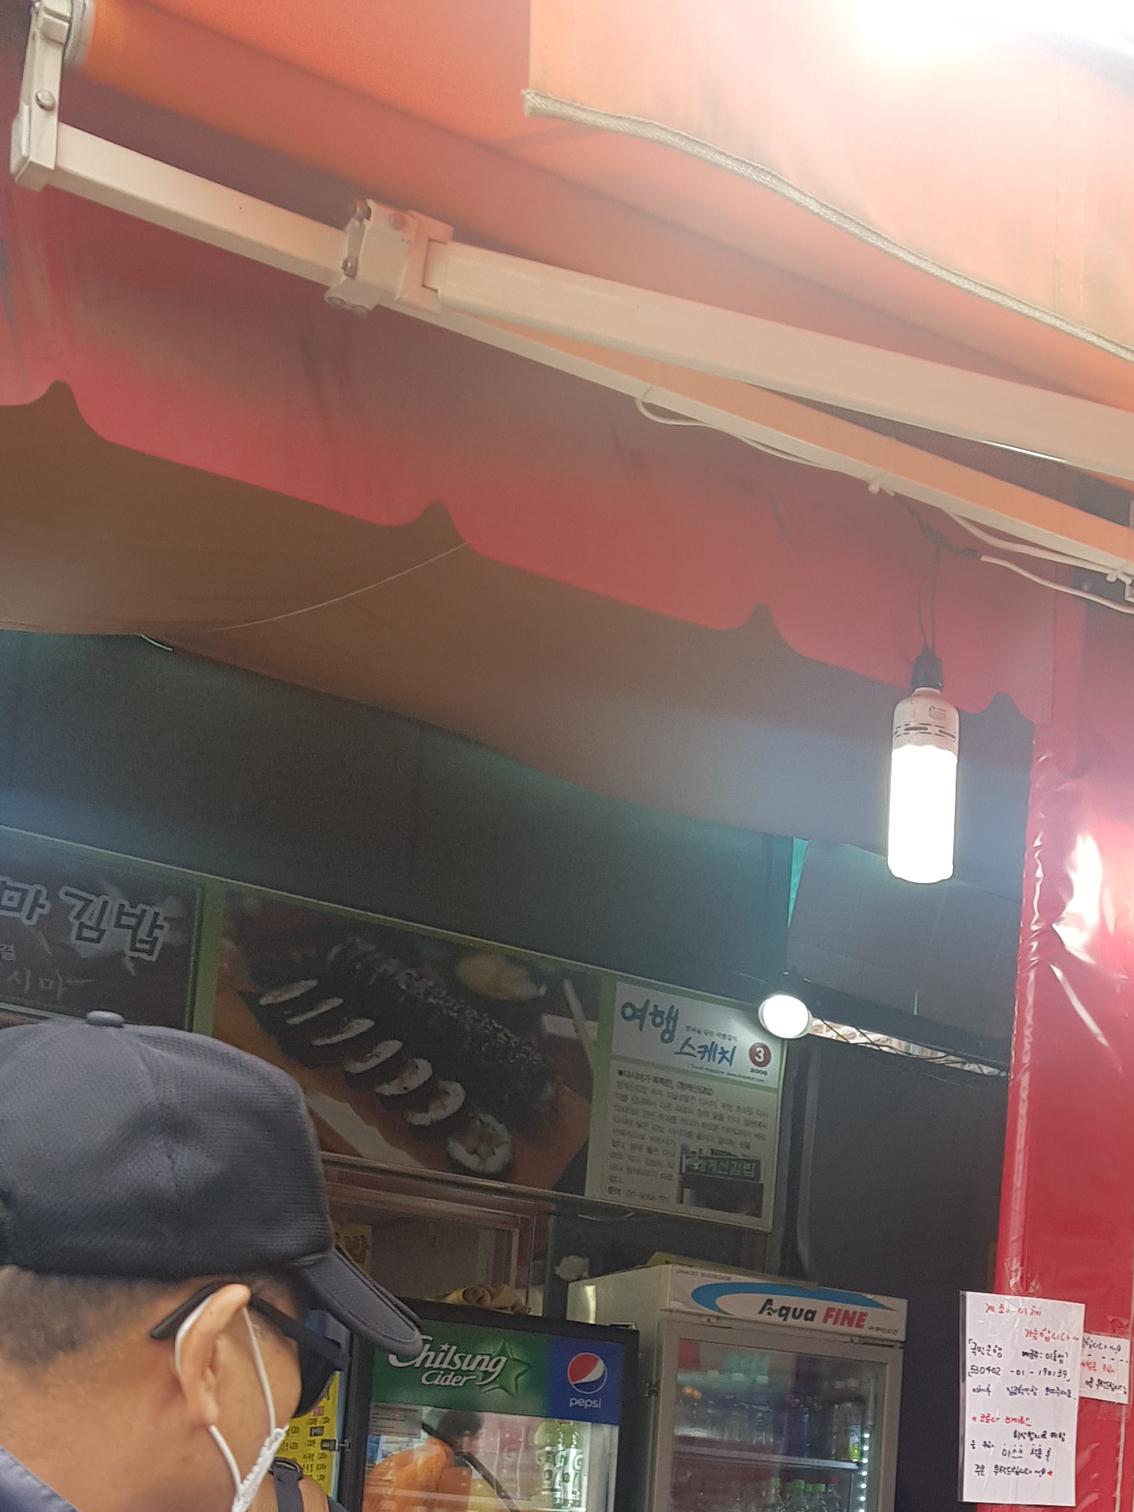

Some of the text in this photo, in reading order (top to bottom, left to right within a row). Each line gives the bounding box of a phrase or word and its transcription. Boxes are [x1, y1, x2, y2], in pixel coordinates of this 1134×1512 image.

[58, 886, 170, 962] 김밥
[621, 999, 680, 1044] 여행
[674, 1036, 737, 1067] 스케치
[758, 1298, 869, 1329] Aqua FINE
[421, 1370, 477, 1388] Cider
[568, 1396, 602, 1409] pepsi
